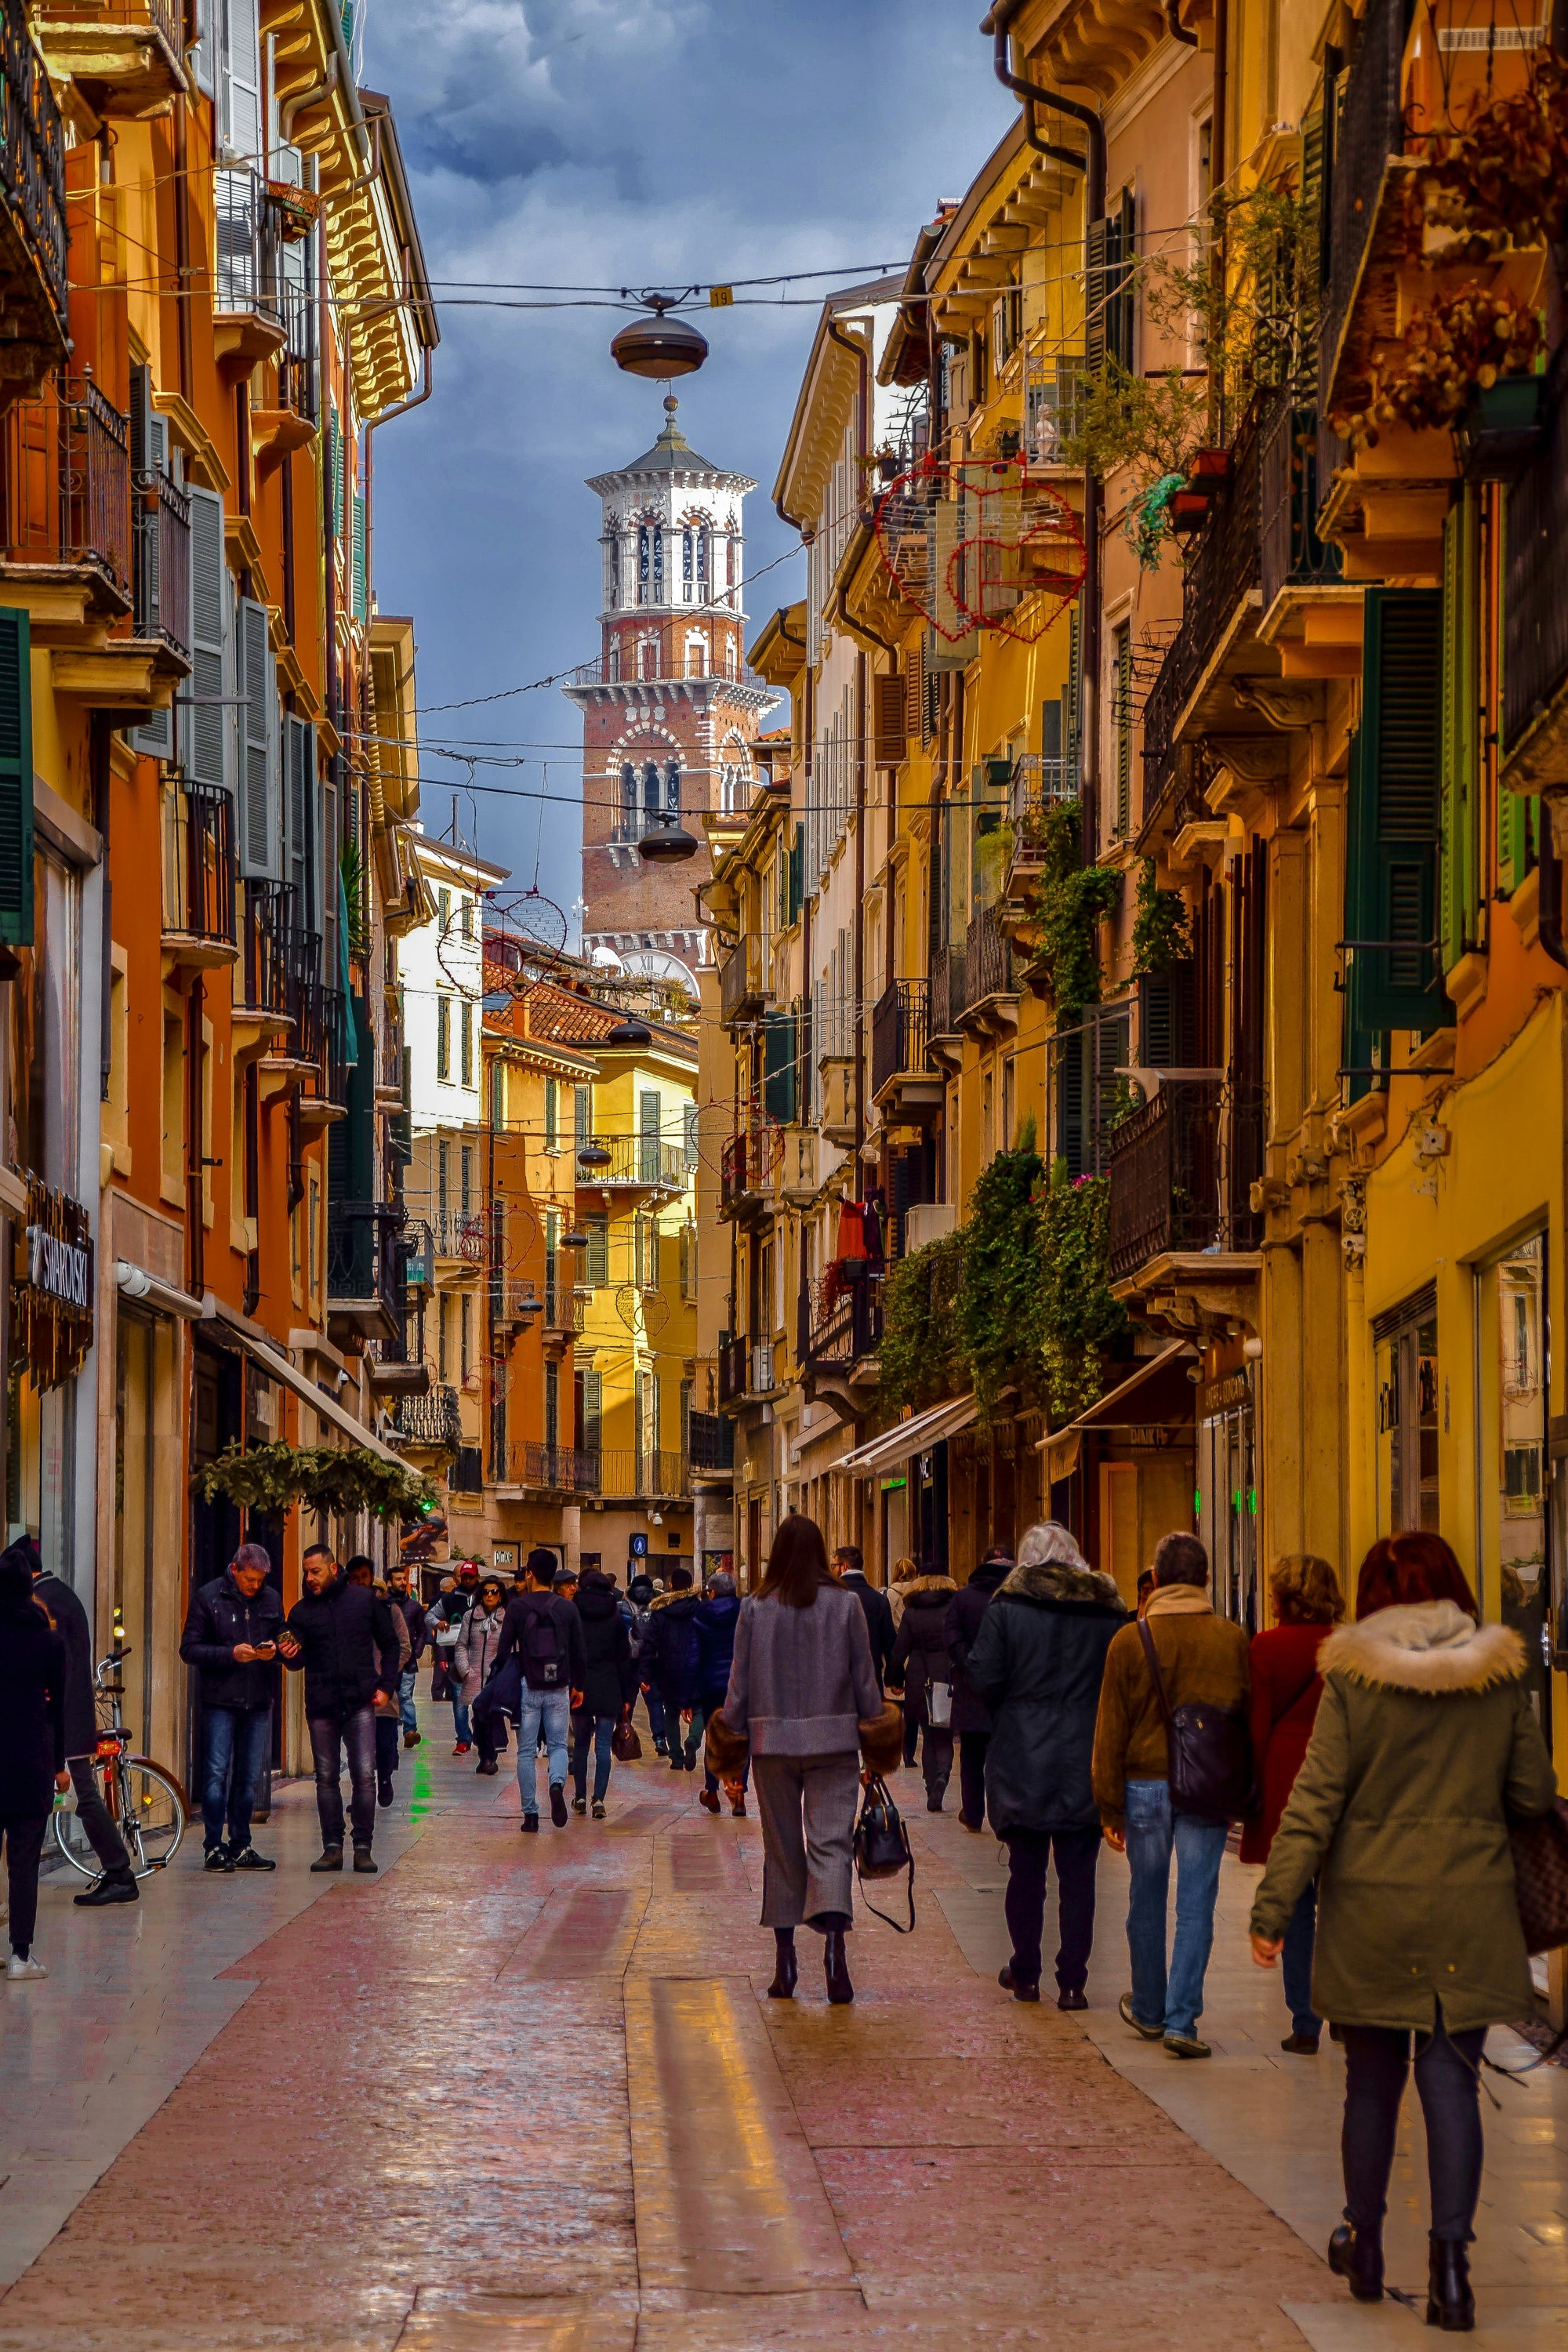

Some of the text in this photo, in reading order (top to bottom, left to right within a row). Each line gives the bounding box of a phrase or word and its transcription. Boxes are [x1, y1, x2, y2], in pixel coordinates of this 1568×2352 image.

[714, 292, 728, 305] 19
[640, 956, 654, 971] XII
[44, 1234, 87, 1307] SWAROVSKI
